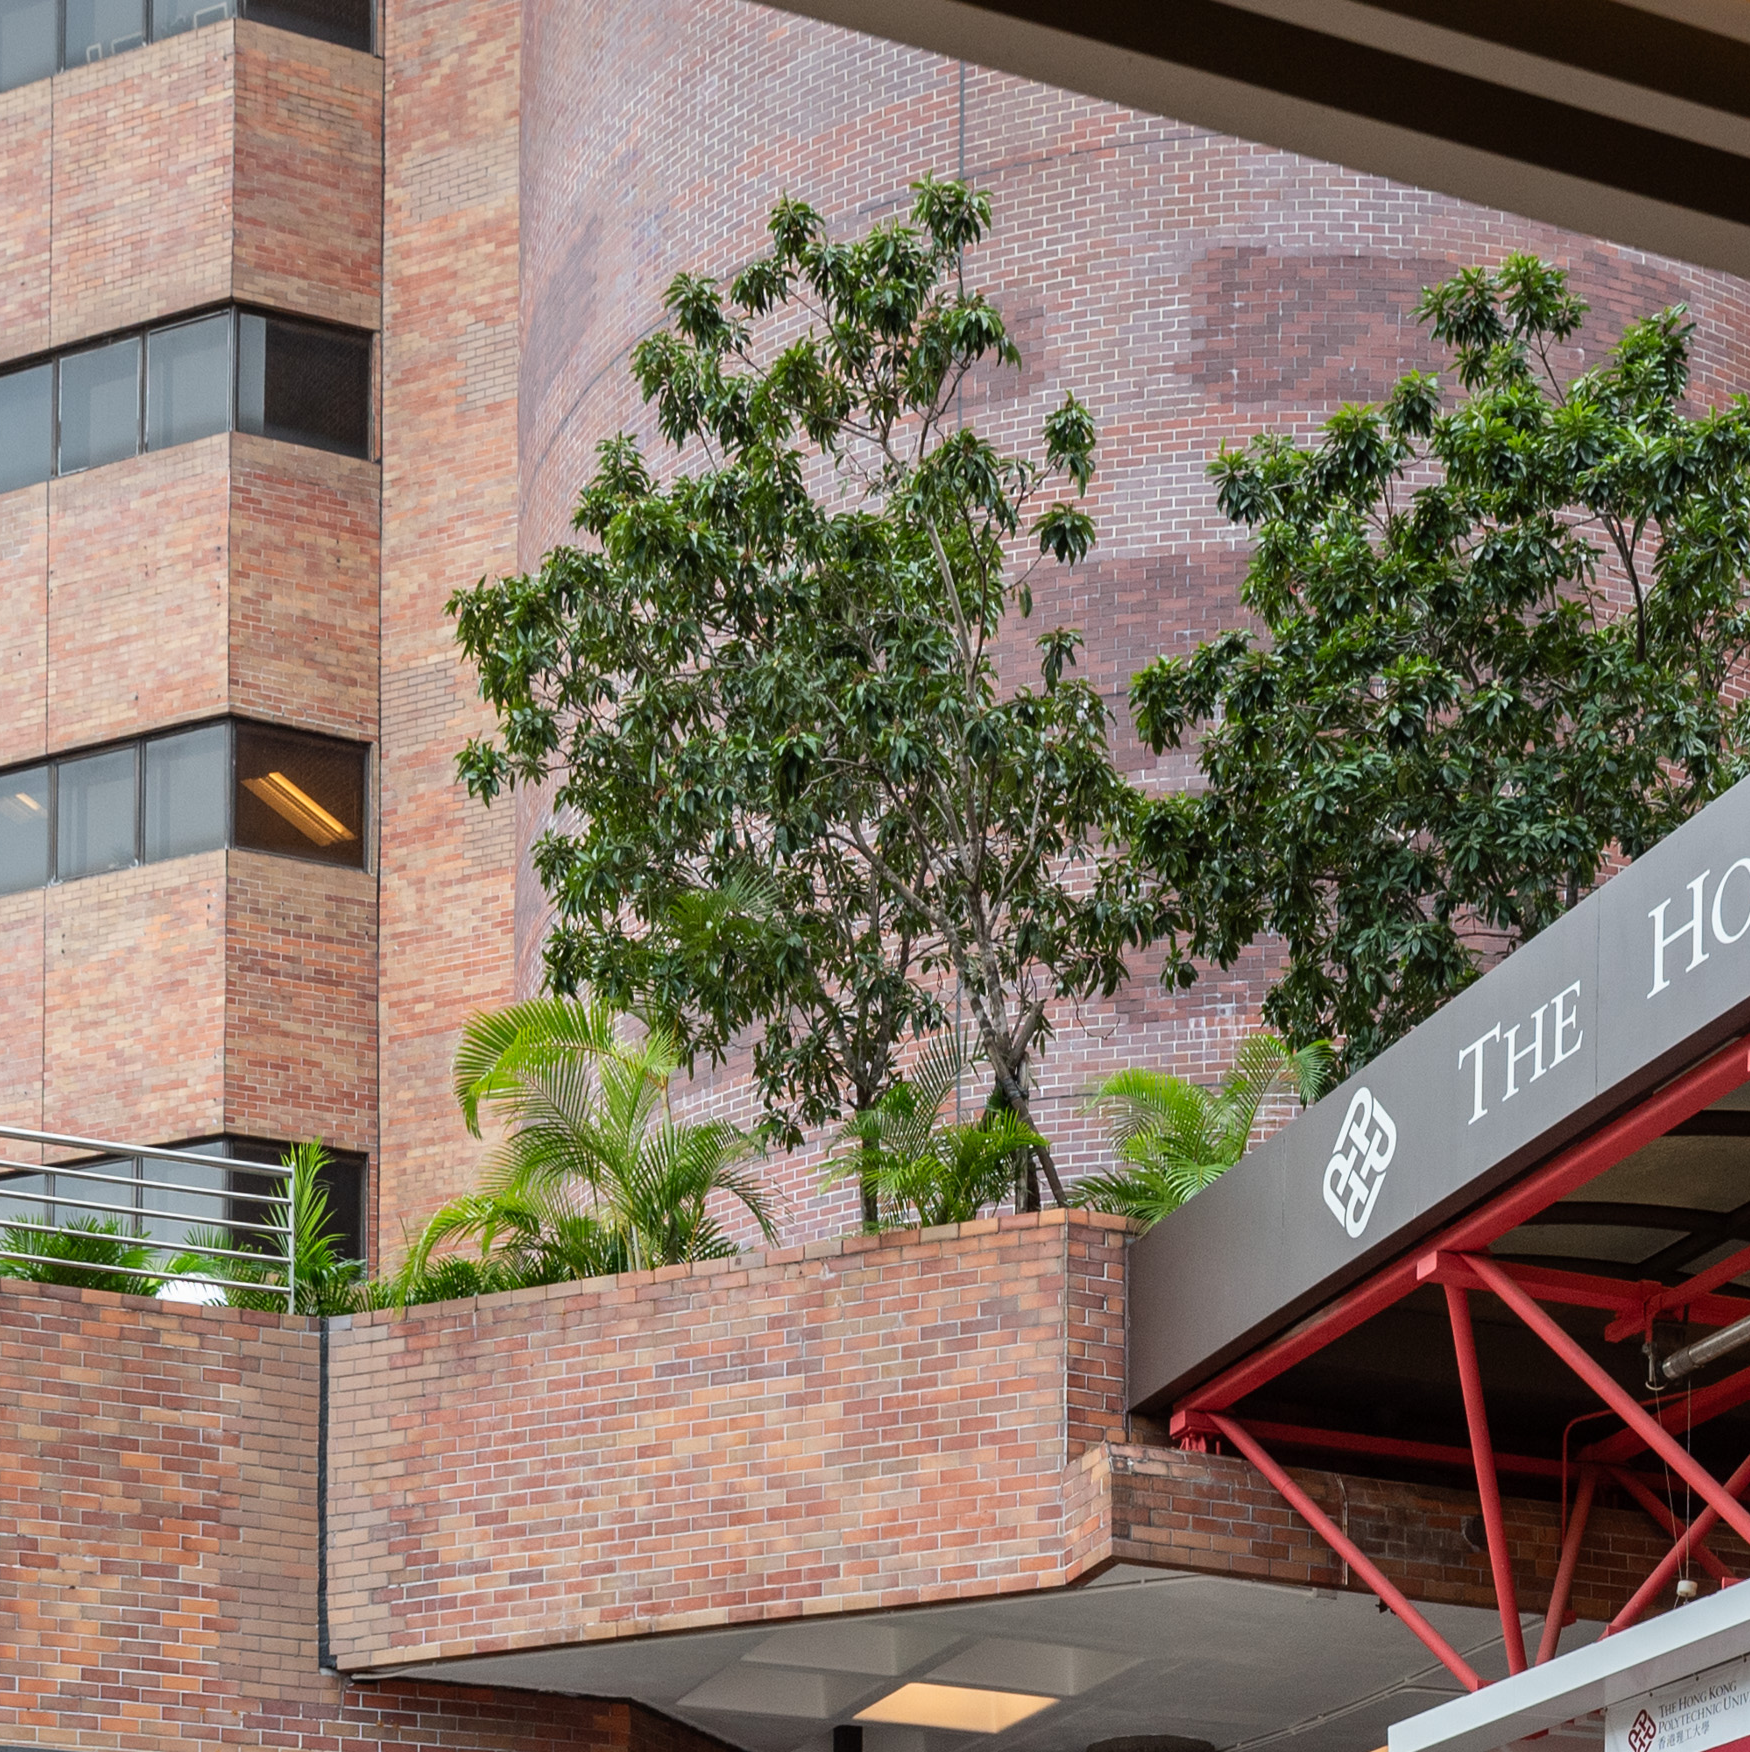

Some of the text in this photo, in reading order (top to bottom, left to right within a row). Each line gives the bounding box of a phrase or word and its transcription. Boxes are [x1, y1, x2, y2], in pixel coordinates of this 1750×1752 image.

[1458, 980, 1584, 1125] THE
[1659, 1680, 1738, 1719] THE HONG KONG
[1658, 1701, 1723, 1735] POLYTECHNIC
[1658, 1721, 1711, 1751] 香港理工大學
